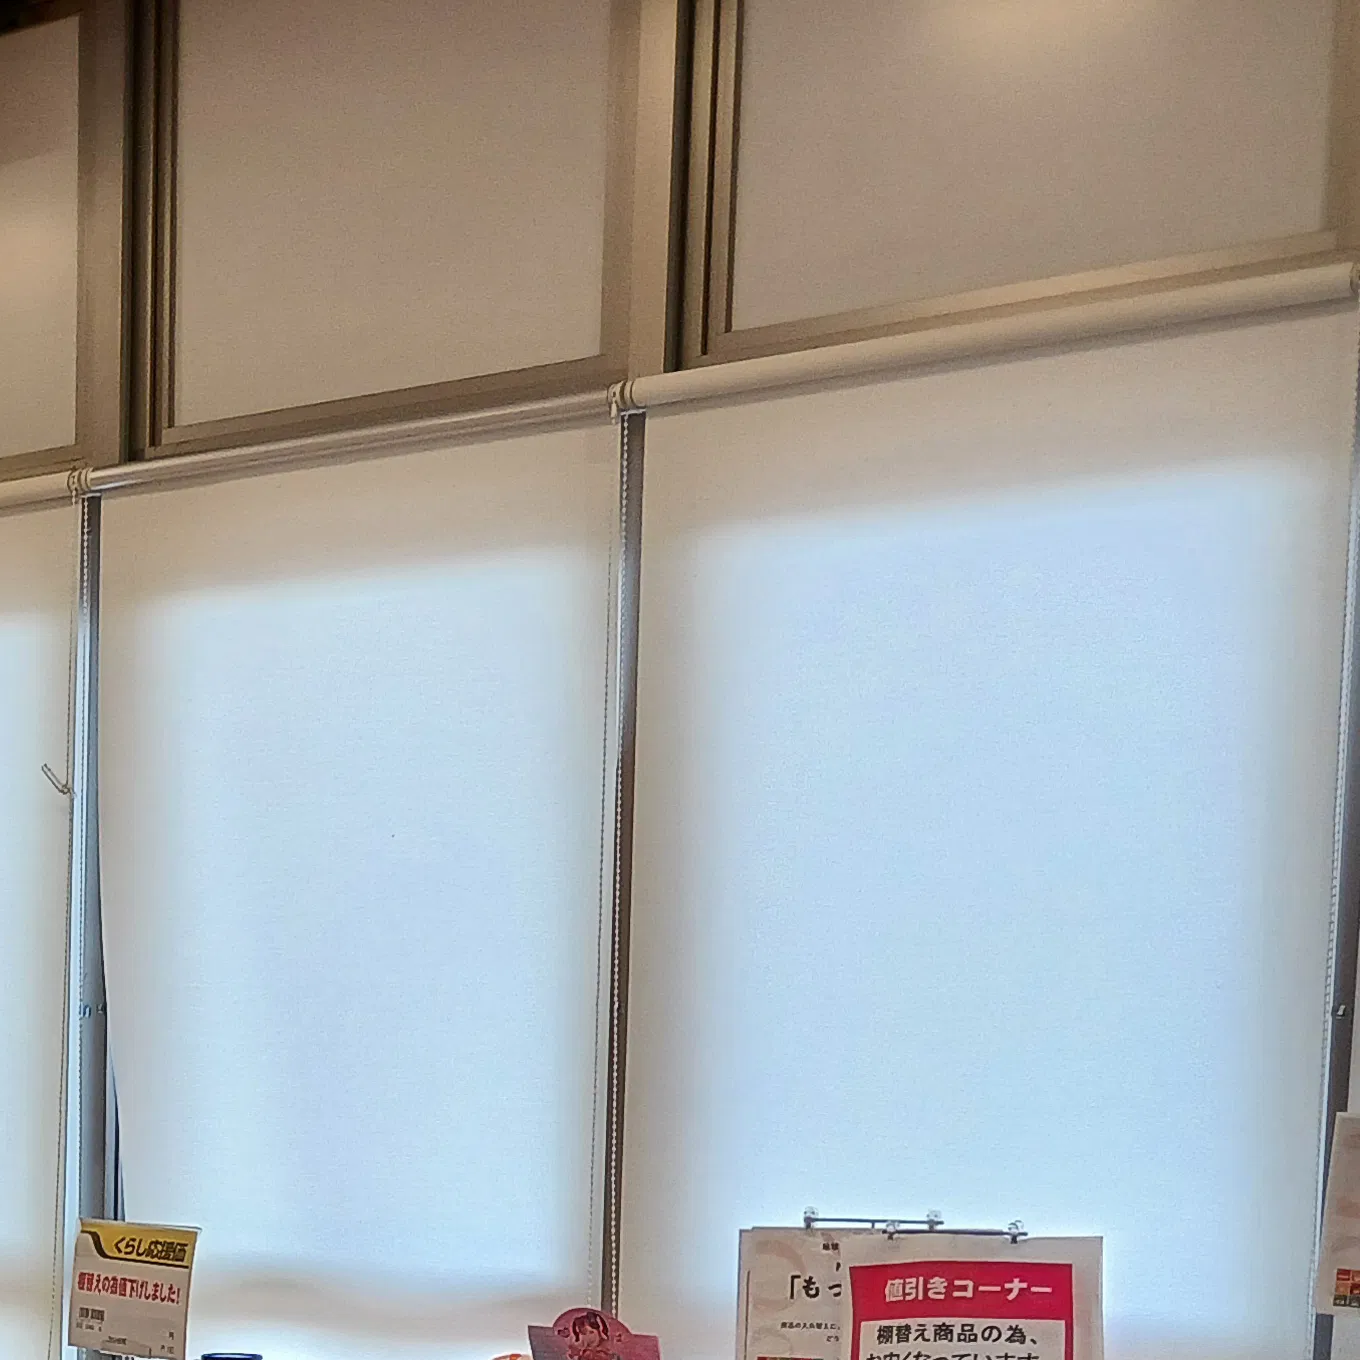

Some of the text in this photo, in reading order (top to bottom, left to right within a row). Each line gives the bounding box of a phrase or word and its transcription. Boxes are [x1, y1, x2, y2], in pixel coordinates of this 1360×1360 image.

[884, 1276, 1053, 1302] 値引きコーナー
[876, 1322, 1038, 1345] 棚替え商品の為、
